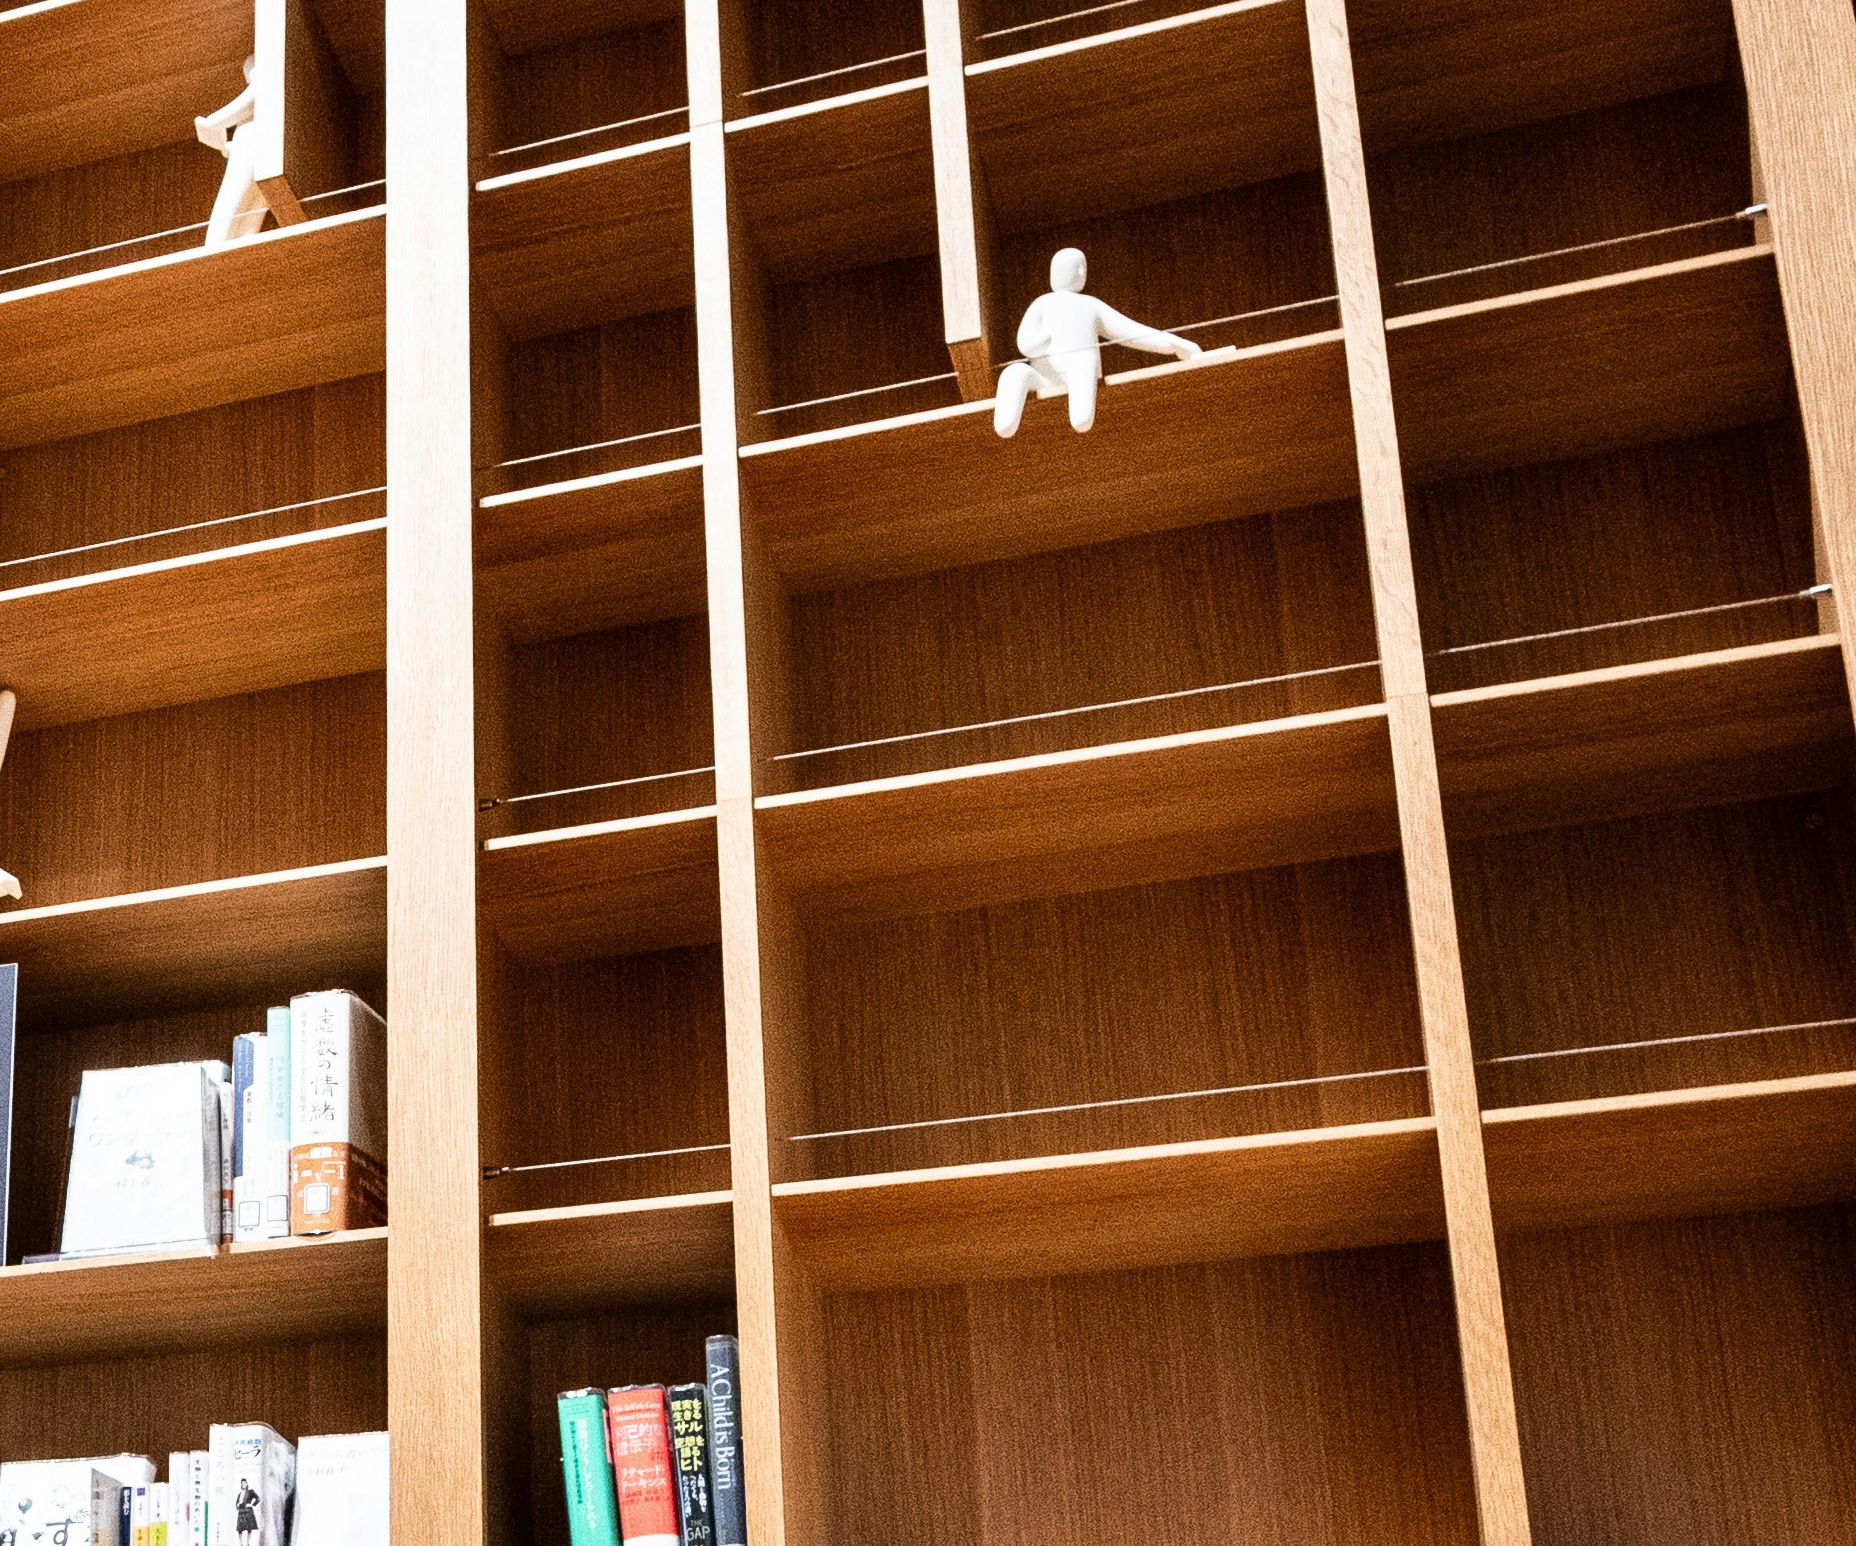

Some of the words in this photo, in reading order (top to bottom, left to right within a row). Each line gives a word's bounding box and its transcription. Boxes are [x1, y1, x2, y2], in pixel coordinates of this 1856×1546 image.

[308, 1007, 339, 1123] 虚数の情緒
[710, 1364, 724, 1378] A
[711, 1380, 732, 1431] Child
[675, 1422, 703, 1434] サル
[716, 1432, 729, 1445] is
[680, 1459, 704, 1472] ヒト
[716, 1445, 736, 1490] Born
[686, 1525, 711, 1541] GAP
